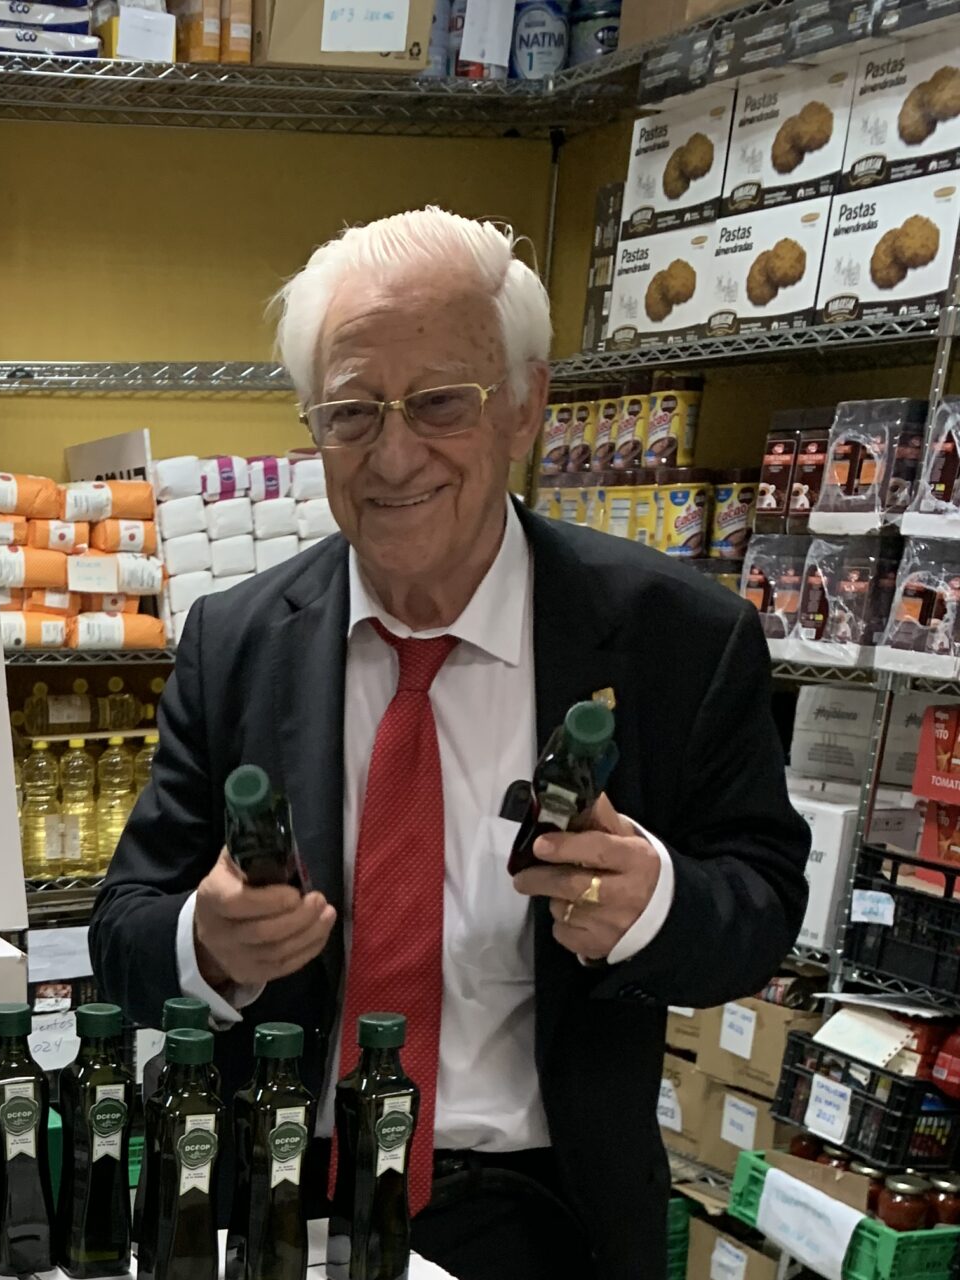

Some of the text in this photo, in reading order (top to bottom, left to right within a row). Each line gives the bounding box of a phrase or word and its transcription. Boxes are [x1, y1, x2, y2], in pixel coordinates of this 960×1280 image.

[519, 32, 565, 48] NATIVA
[528, 53, 532, 71] 1
[865, 57, 905, 79] Pastas
[744, 91, 778, 111] Pastas
[639, 125, 668, 142] Pastas
[839, 202, 876, 222] Pastas
[720, 227, 752, 243] Pastas
[622, 248, 649, 263] Pastas
